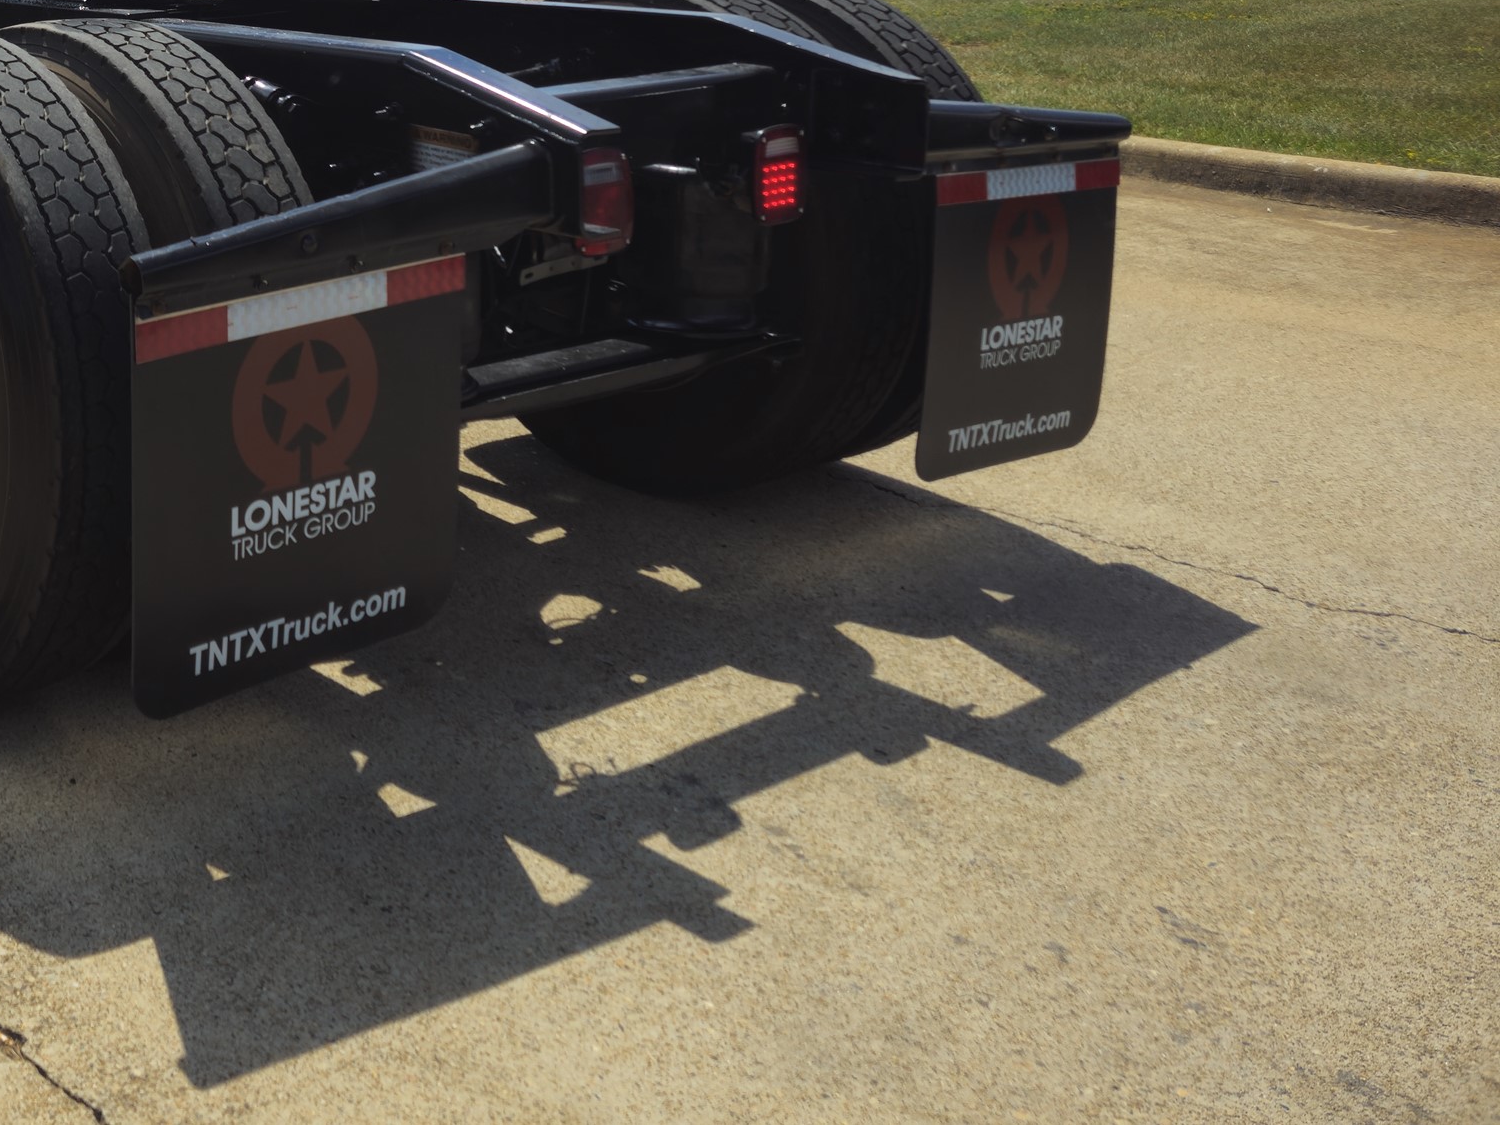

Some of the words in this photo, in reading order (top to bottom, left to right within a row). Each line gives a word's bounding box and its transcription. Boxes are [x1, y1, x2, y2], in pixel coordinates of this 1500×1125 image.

[980, 315, 1063, 351] LONESTAR
[980, 346, 1017, 370] TRUCK
[1019, 339, 1062, 362] GROUP
[948, 409, 1071, 453] TNTXTruck.com
[231, 470, 377, 538] LONESTAR
[232, 521, 298, 561] TRUCK
[304, 501, 377, 540] GROUP
[189, 586, 406, 677] TNTXTruck.com
